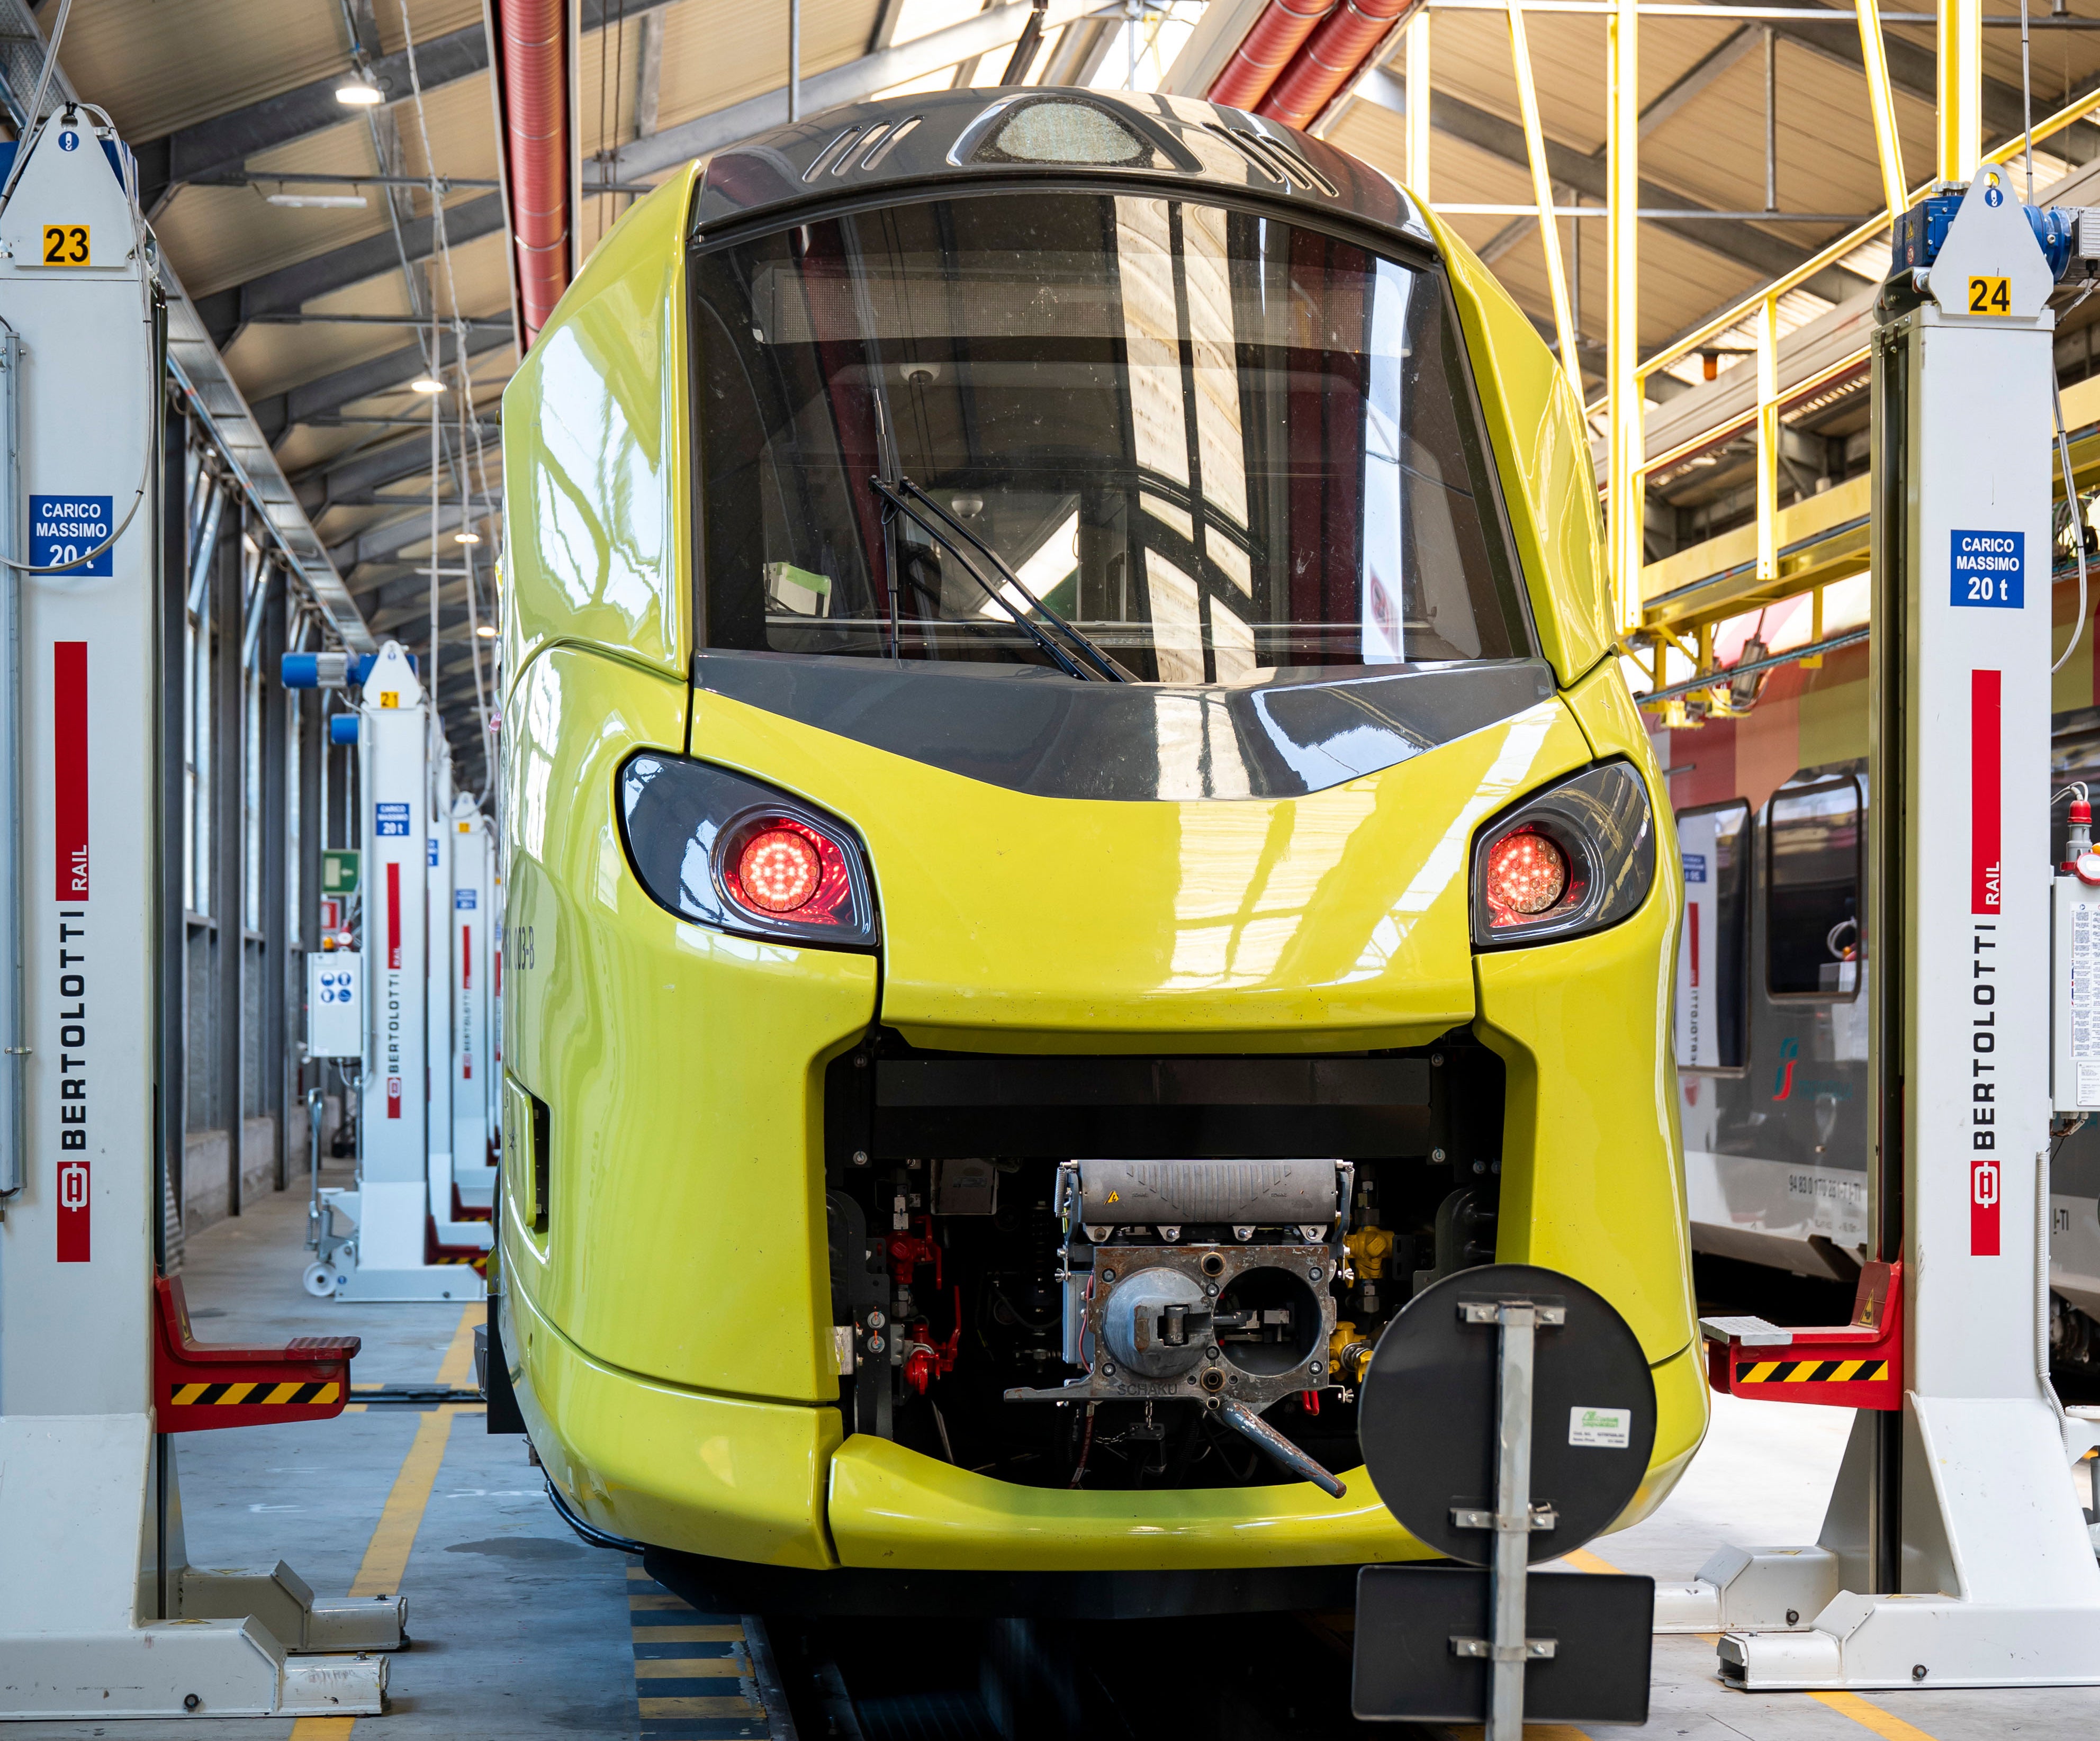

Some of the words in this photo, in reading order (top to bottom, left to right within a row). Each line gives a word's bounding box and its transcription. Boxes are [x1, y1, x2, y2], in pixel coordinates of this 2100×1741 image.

[46, 228, 89, 263] 23
[1970, 279, 2010, 312] 24
[42, 503, 101, 518] CARICO
[36, 522, 107, 537] MASSIMO
[49, 544, 77, 567] 20
[1962, 537, 2014, 553] CARICO
[1957, 555, 2020, 571] MASSIMO
[1968, 576, 1994, 600] 20
[1999, 579, 2008, 600] t
[381, 692, 398, 707] 21
[72, 844, 87, 891] RAIL
[1986, 861, 1999, 905] RAIL
[60, 912, 86, 1150] BERTOLOTTI
[389, 974, 400, 1072] BERTOLOTTI
[1973, 925, 1996, 1150] BERTOLOTTI
[1117, 1383, 1177, 1395] SCHAKU
